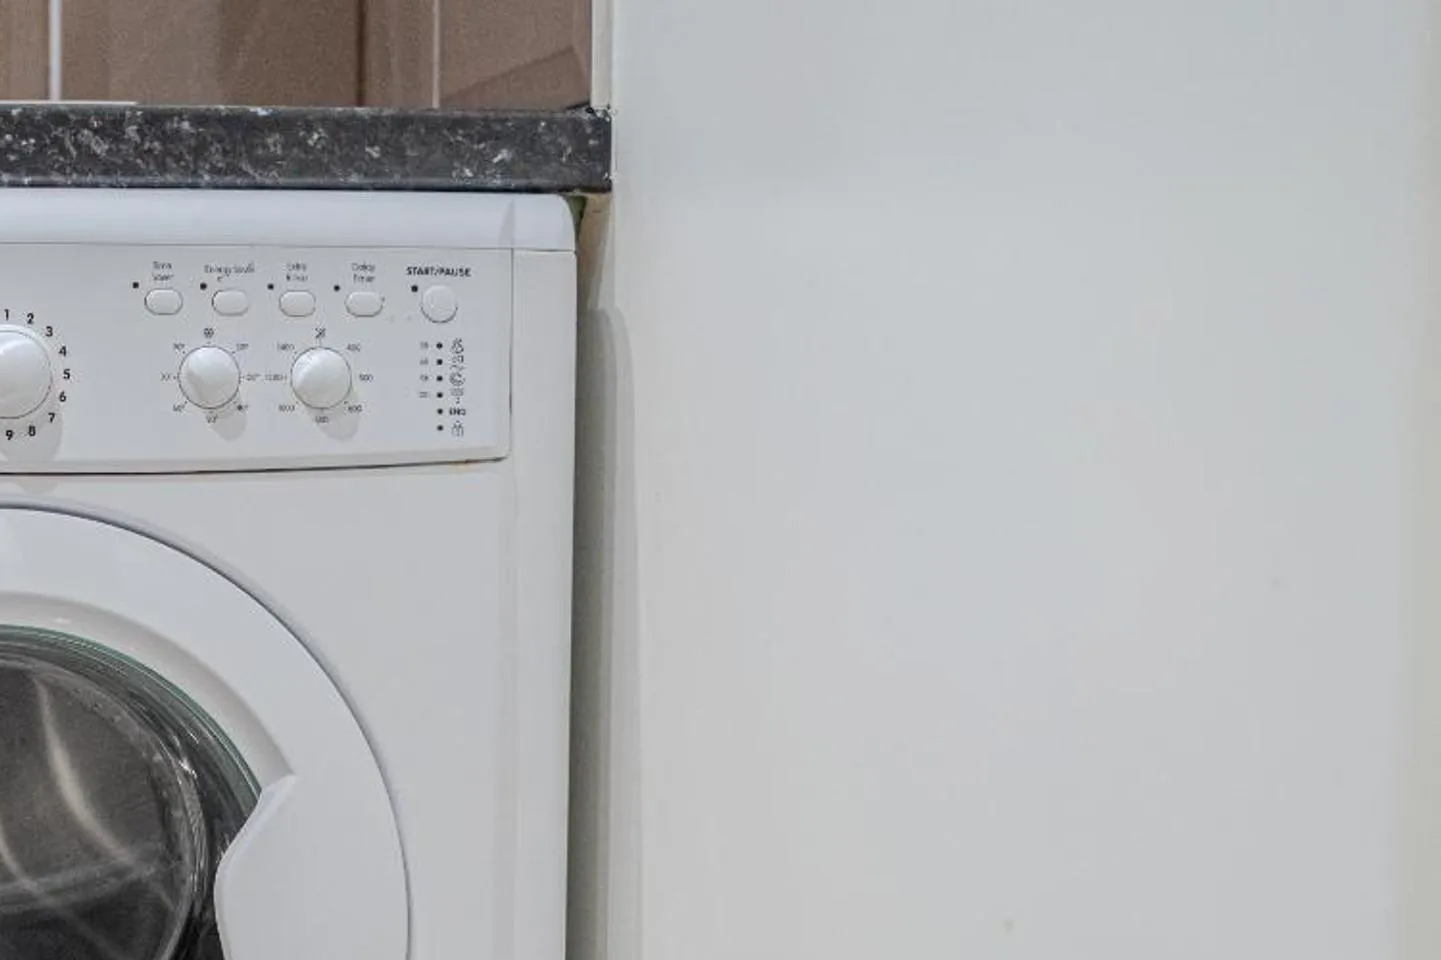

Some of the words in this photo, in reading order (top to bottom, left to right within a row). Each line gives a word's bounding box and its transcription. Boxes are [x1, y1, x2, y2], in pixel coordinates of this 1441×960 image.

[406, 266, 472, 277] START/PAUSE
[4, 309, 10, 321] 1
[26, 312, 35, 324] 2
[45, 326, 53, 337] 3
[59, 345, 67, 357] 4
[62, 368, 71, 380] 5
[59, 391, 67, 402] 6
[48, 412, 56, 423] 7
[5, 429, 14, 440] 9
[28, 426, 36, 437] 8
